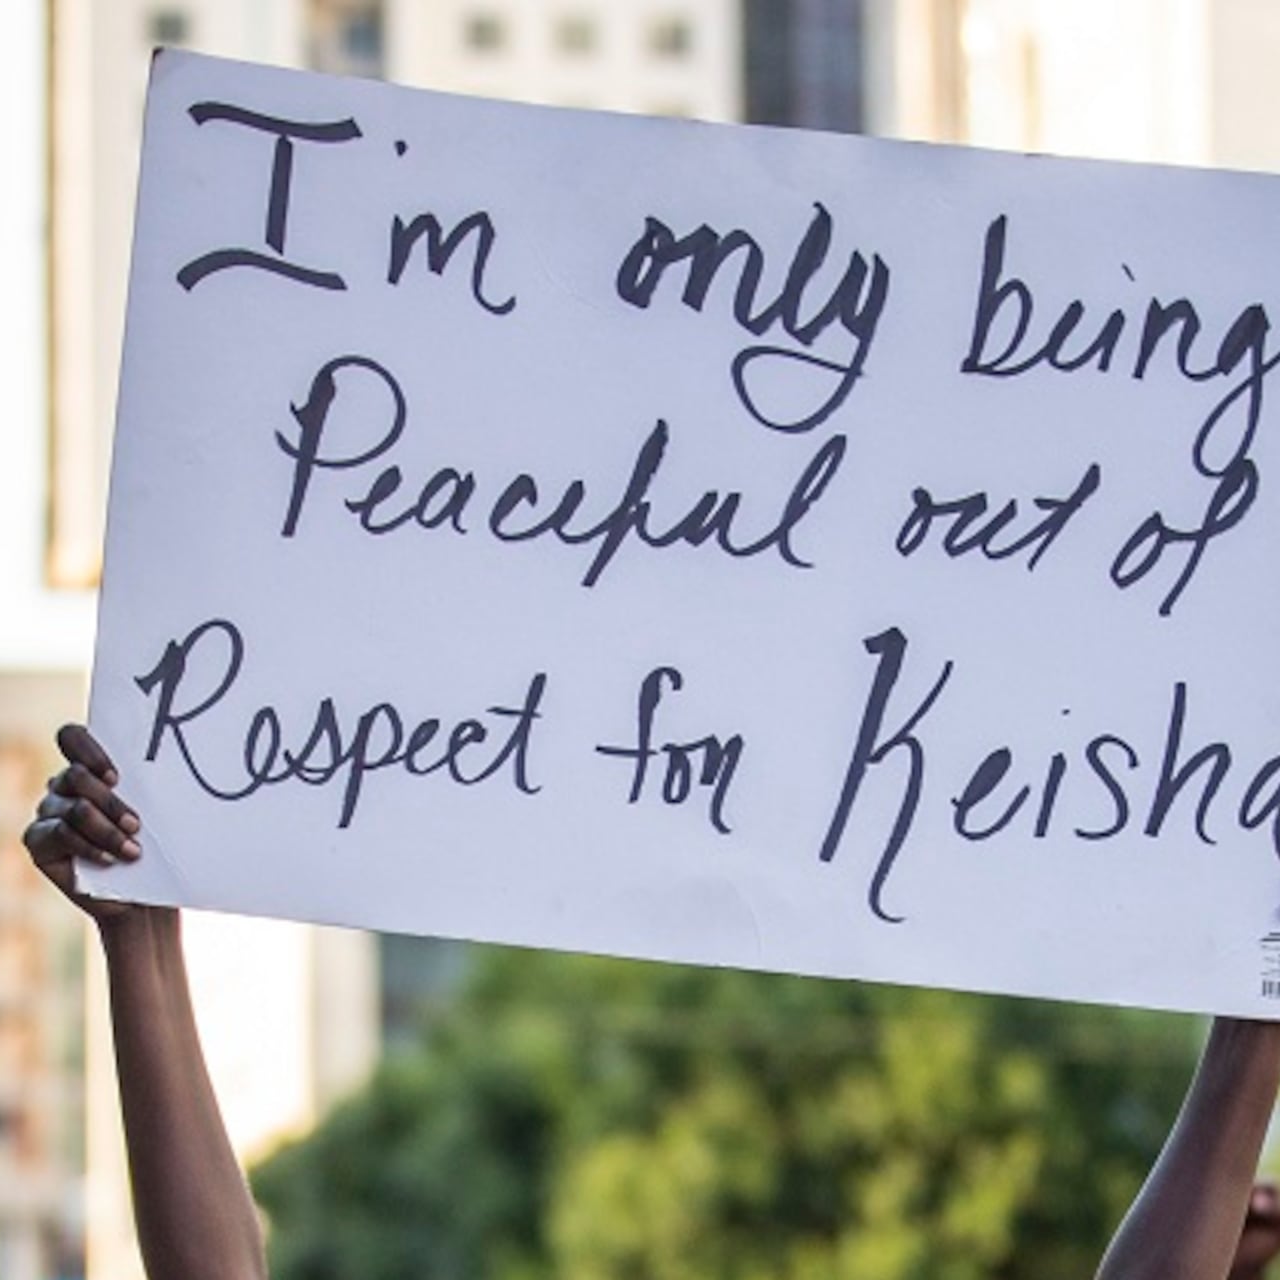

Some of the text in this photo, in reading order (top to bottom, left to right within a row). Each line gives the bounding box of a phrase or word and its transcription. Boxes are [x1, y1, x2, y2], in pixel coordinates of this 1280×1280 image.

[176, 101, 516, 315] I'm
[615, 202, 891, 434] only
[274, 355, 1260, 617] Peaceful out of
[133, 618, 547, 829] Respect
[595, 666, 744, 834] for
